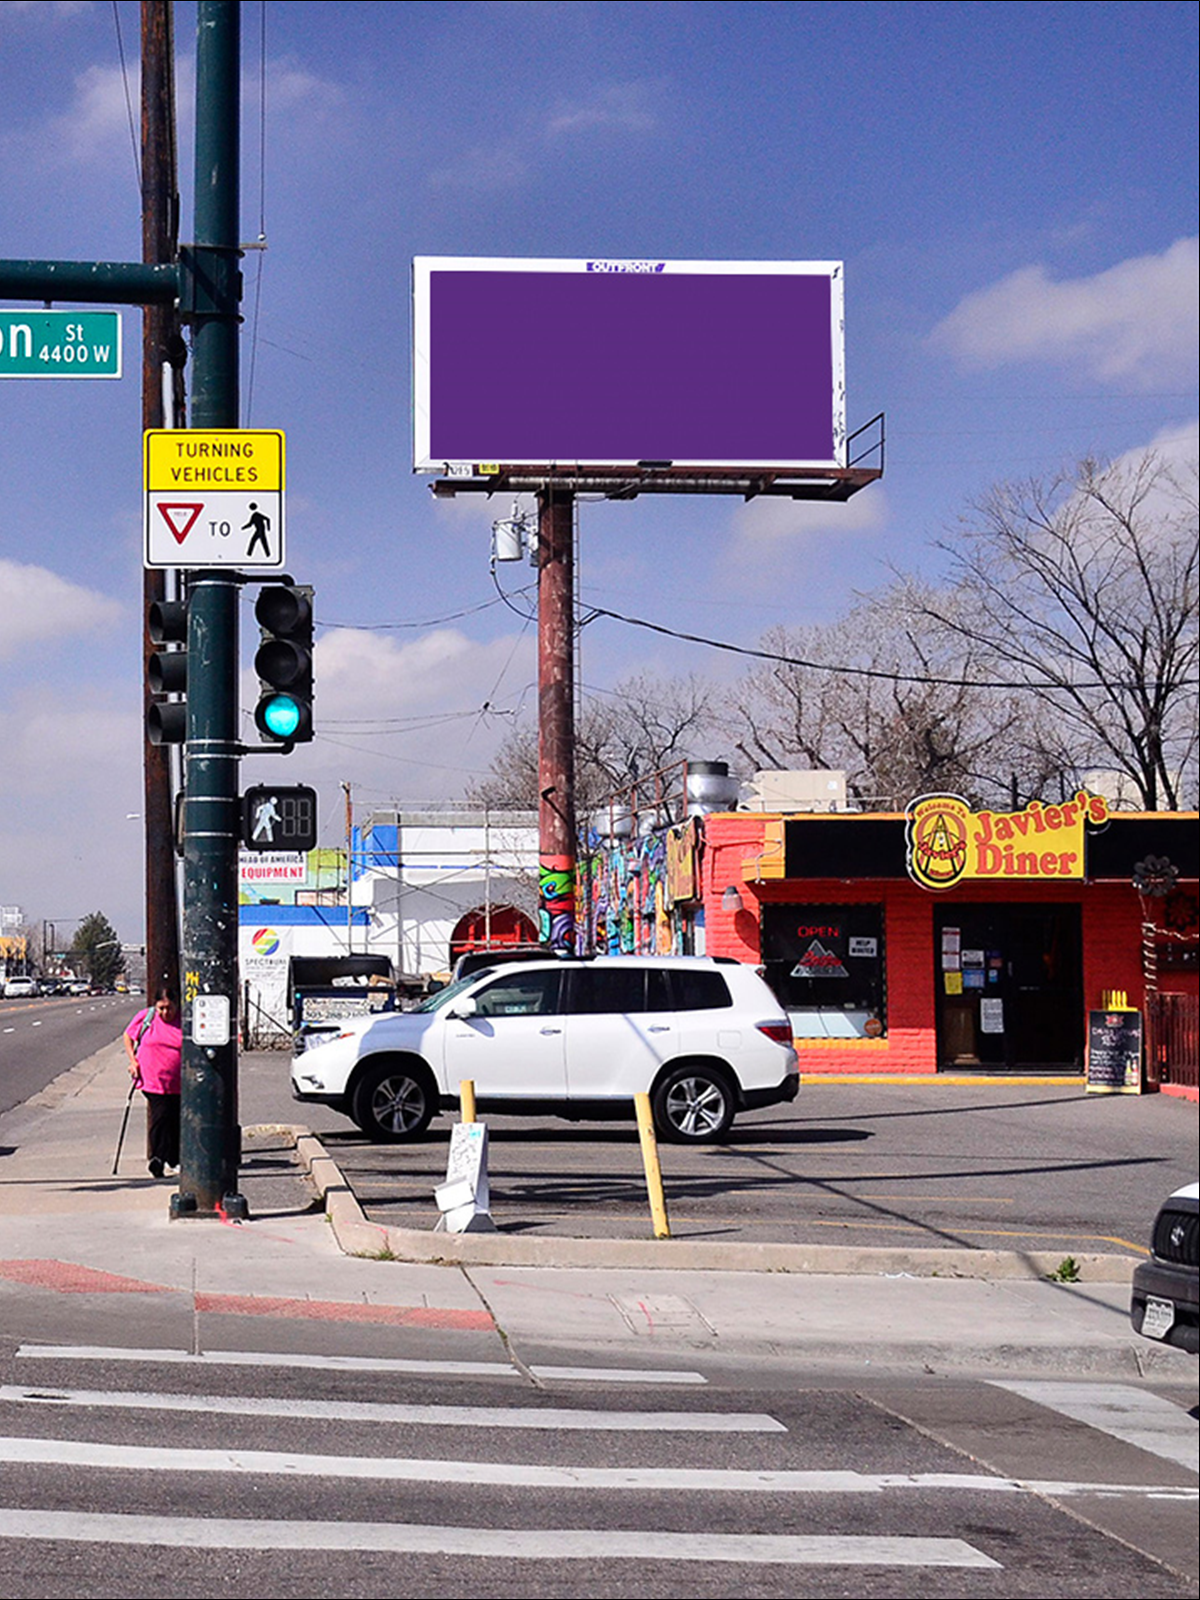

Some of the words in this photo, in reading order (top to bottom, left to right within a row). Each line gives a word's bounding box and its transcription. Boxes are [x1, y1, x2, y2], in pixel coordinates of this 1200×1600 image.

[65, 323, 84, 342] St
[38, 344, 89, 363] 4400
[93, 344, 110, 363] W
[176, 442, 254, 458] TURNING
[170, 466, 259, 482] VEHICLES
[208, 520, 231, 537] TO
[973, 791, 1107, 844] Javier's
[974, 842, 1078, 876] Diner
[241, 867, 304, 880] EQUIPMENT
[798, 926, 839, 937] OPEN
